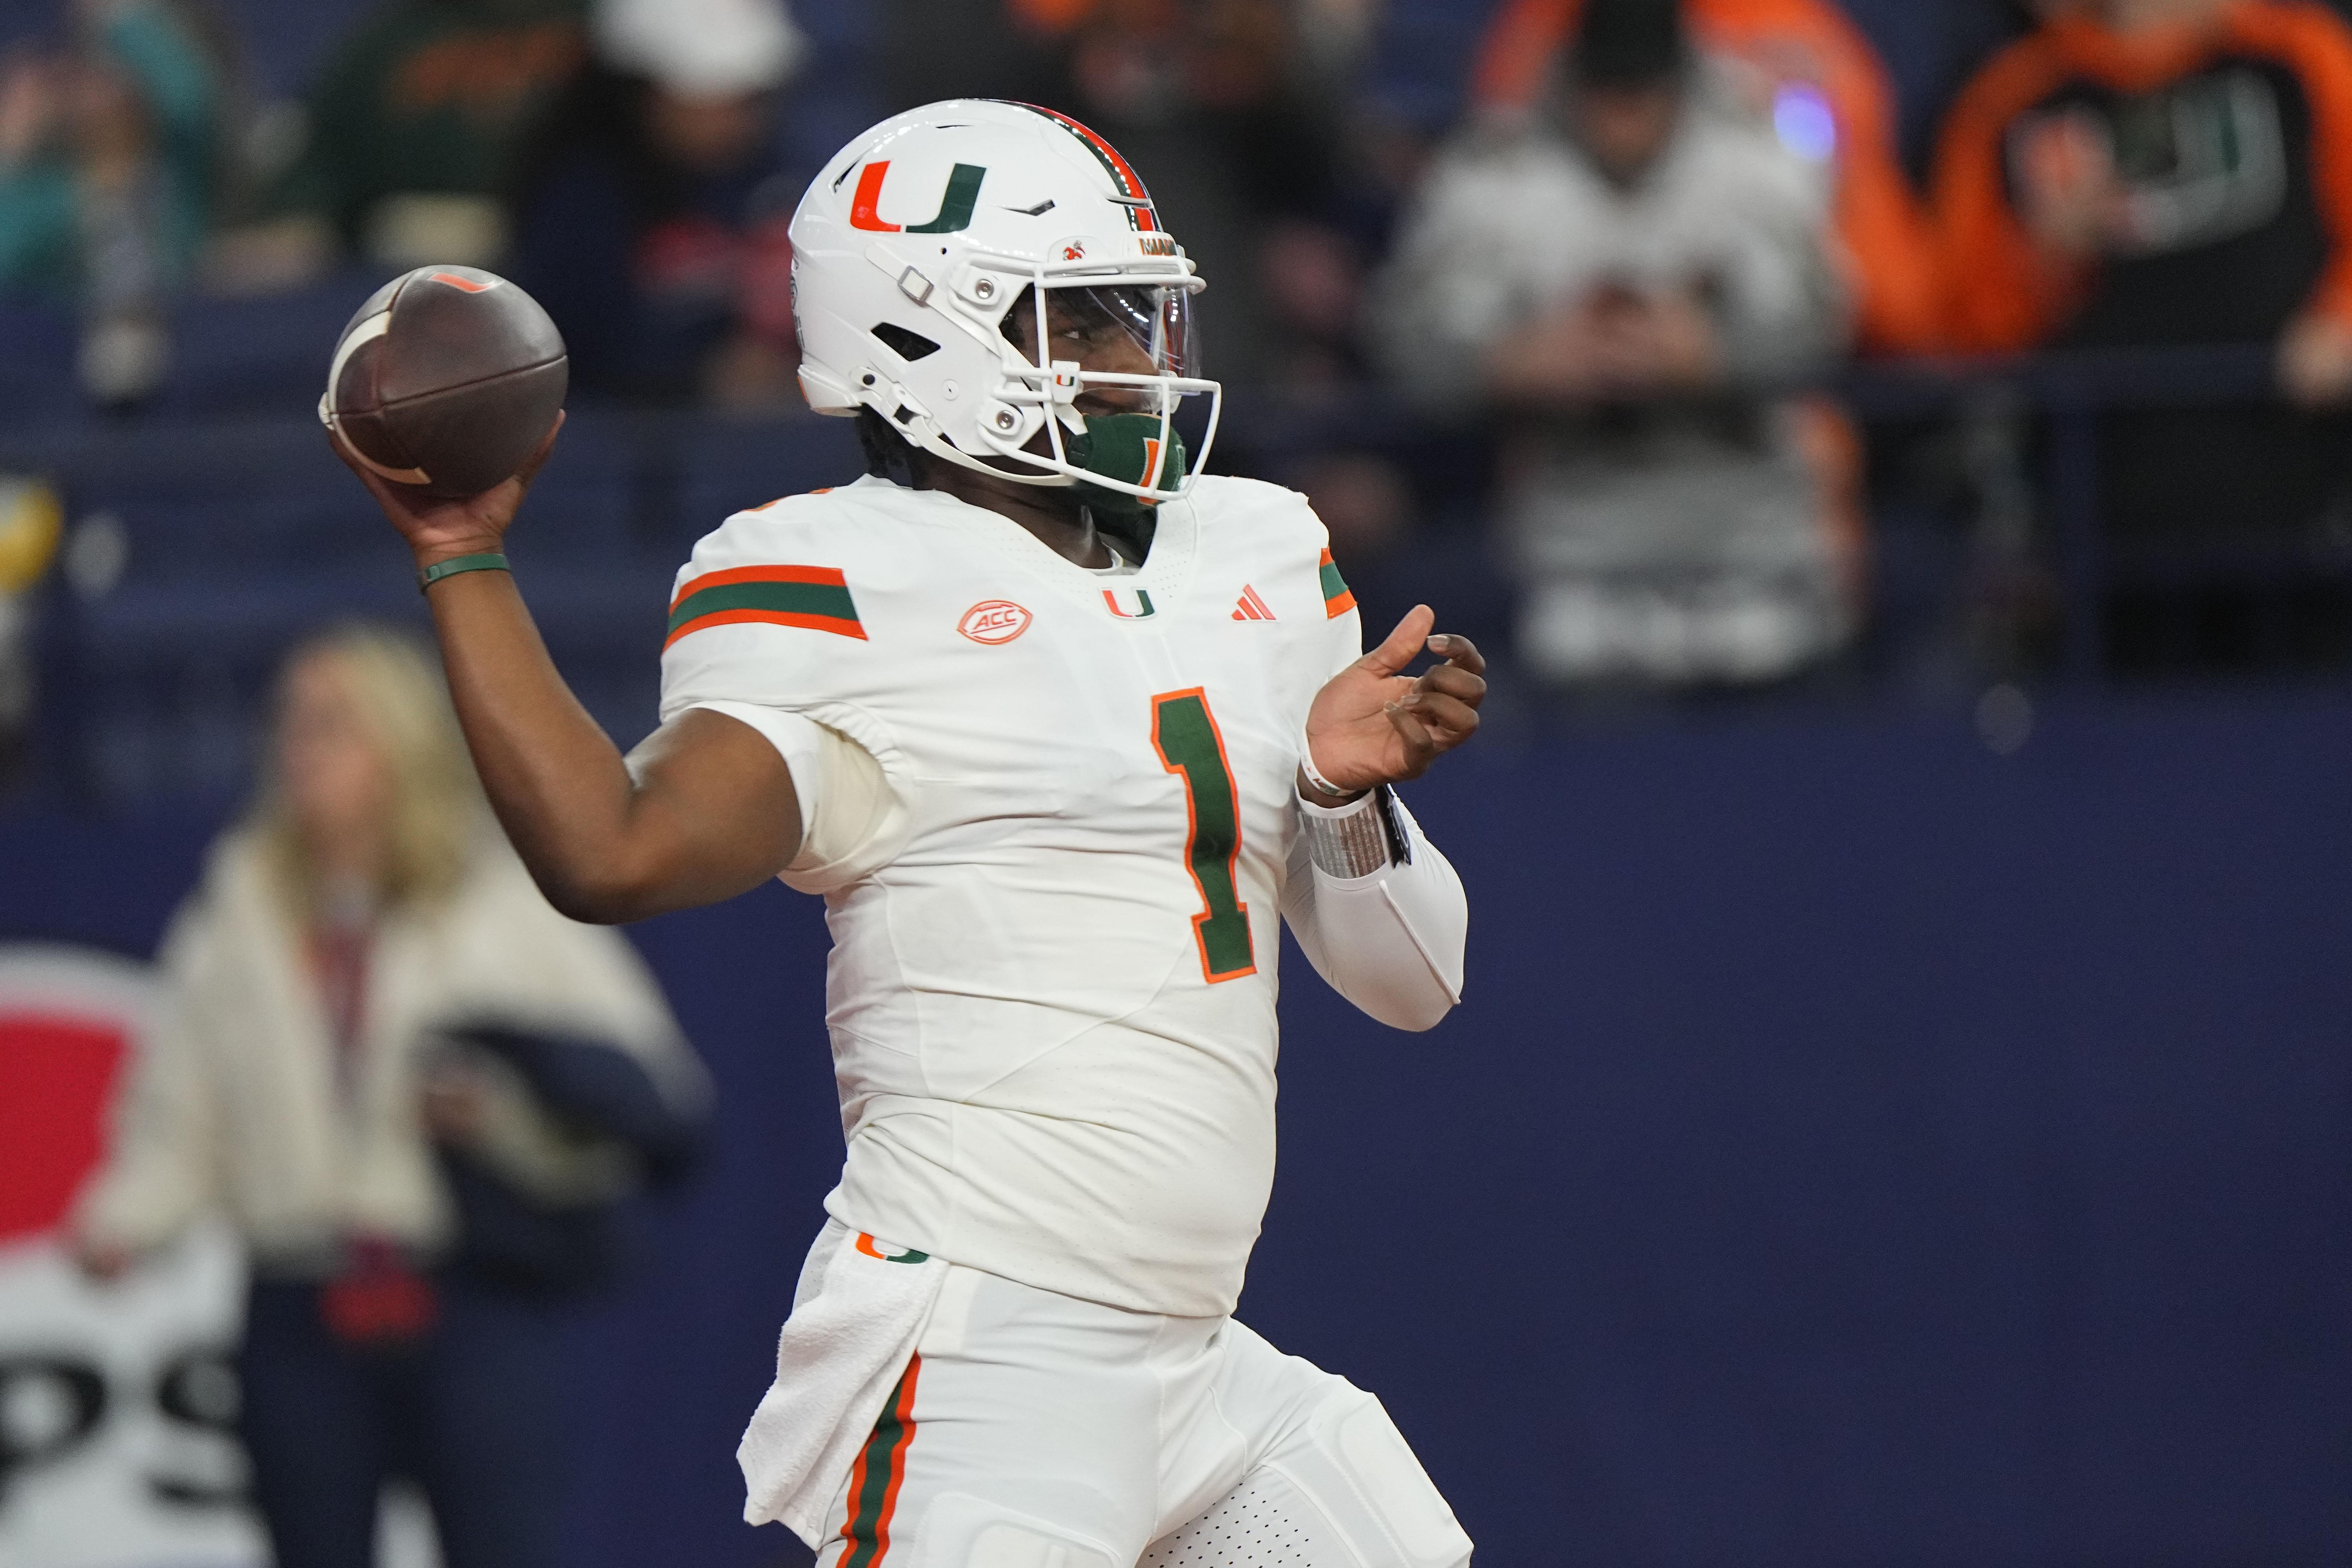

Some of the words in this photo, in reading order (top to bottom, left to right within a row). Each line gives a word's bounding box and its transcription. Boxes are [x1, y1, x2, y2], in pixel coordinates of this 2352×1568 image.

[850, 160, 987, 234] U
[1057, 374, 1074, 386] U
[1102, 589, 1155, 617] U
[973, 609, 1016, 629] ACC
[1151, 686, 1257, 984] 1
